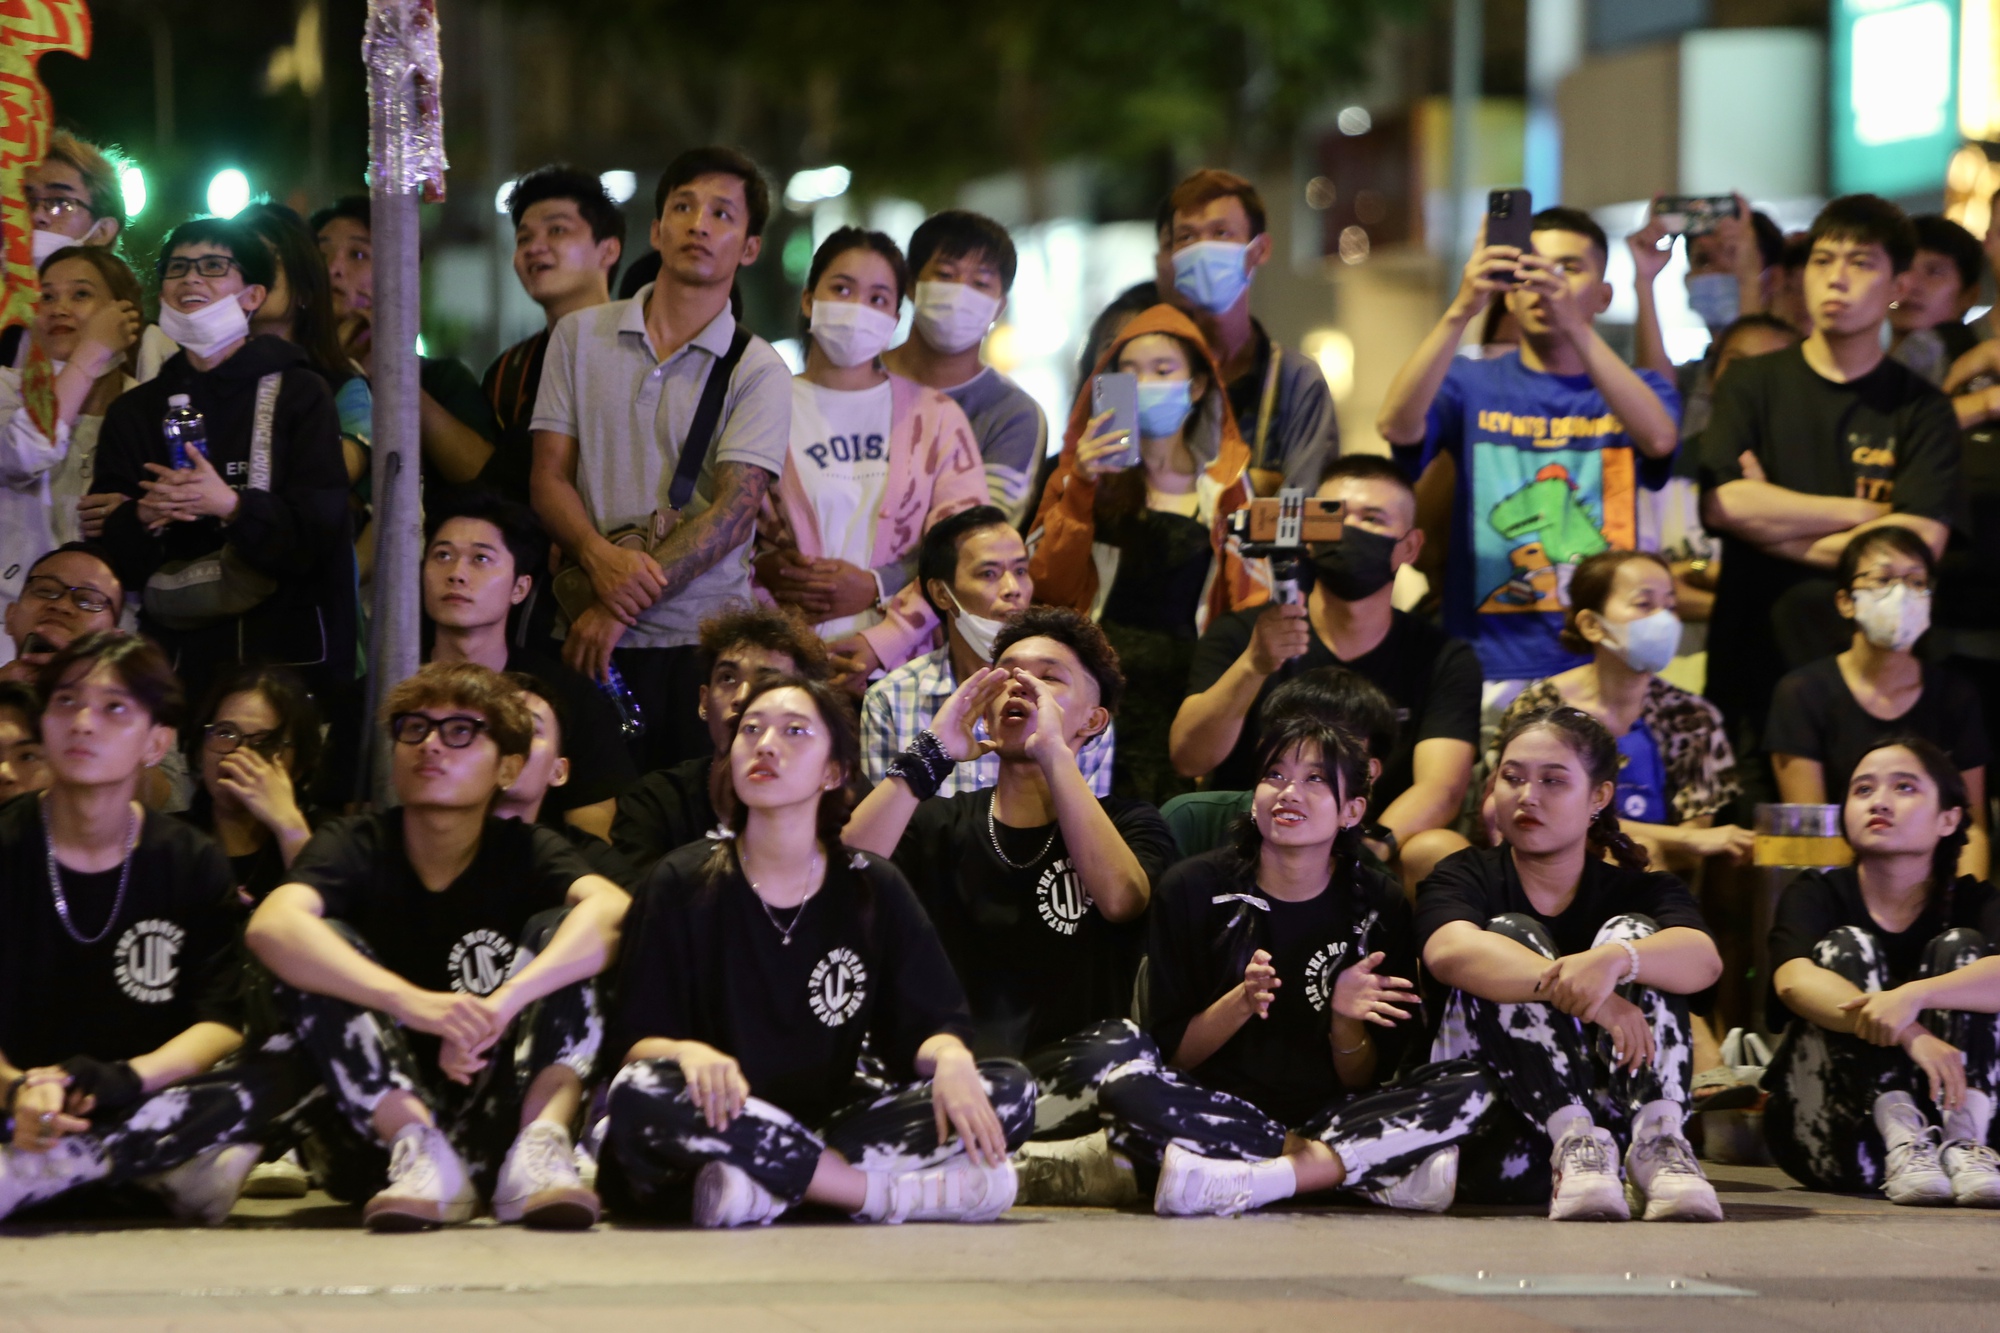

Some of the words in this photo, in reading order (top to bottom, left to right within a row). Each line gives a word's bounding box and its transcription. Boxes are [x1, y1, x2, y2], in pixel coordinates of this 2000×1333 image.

[804, 432, 889, 469] POIS
[1036, 869, 1056, 895] THE
[807, 959, 831, 988] THE
[1304, 950, 1328, 977] THE
